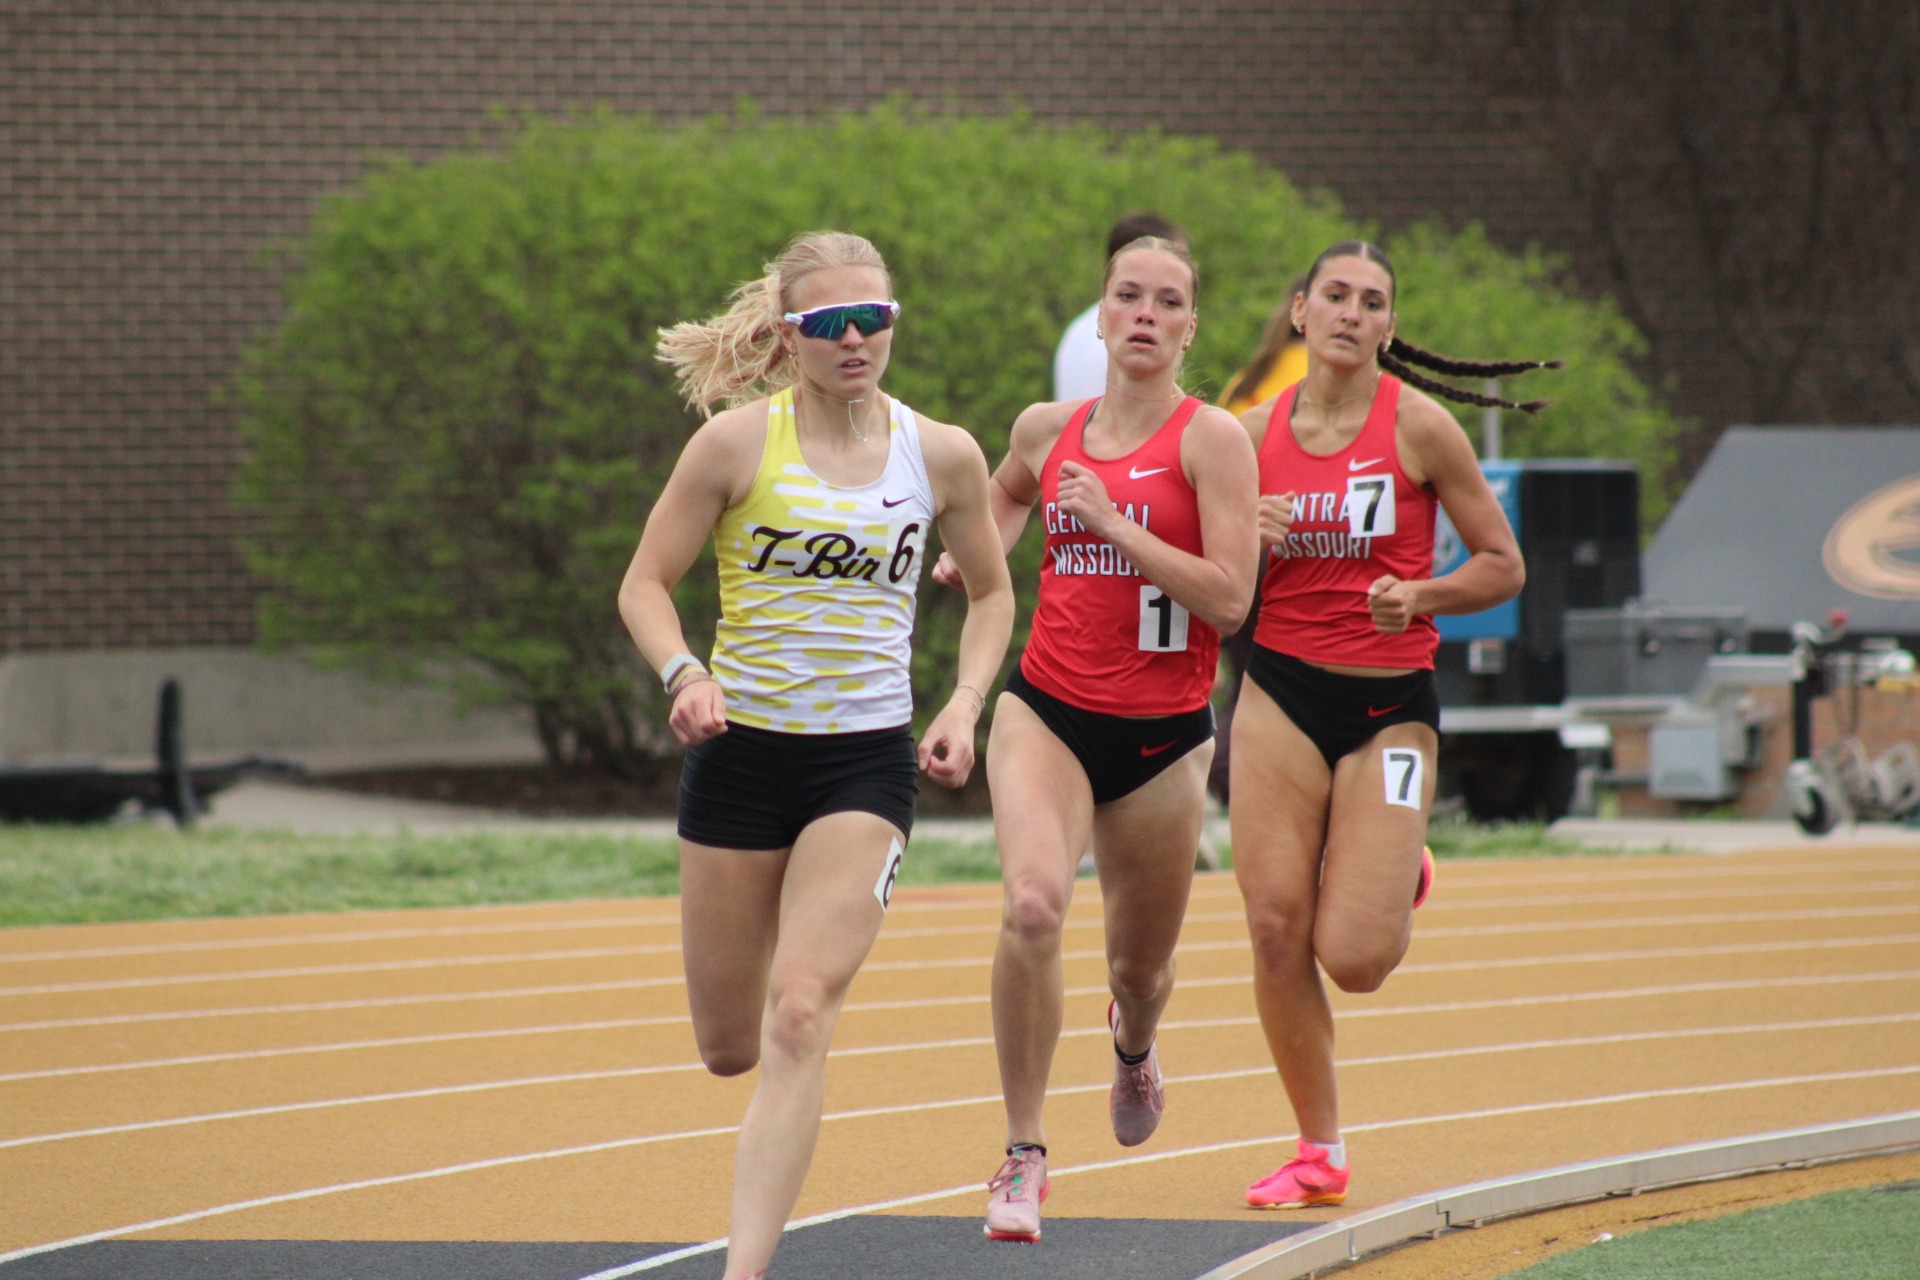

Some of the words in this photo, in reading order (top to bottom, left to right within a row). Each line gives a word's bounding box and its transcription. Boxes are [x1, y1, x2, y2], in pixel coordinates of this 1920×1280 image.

[1288, 492, 1351, 522] NTRA
[1354, 480, 1386, 533] 7
[747, 525, 881, 581] T-Bir
[889, 523, 919, 583] 6
[1049, 543, 1141, 577] MISSOU
[1148, 592, 1172, 648] 1
[1389, 753, 1417, 801] 7
